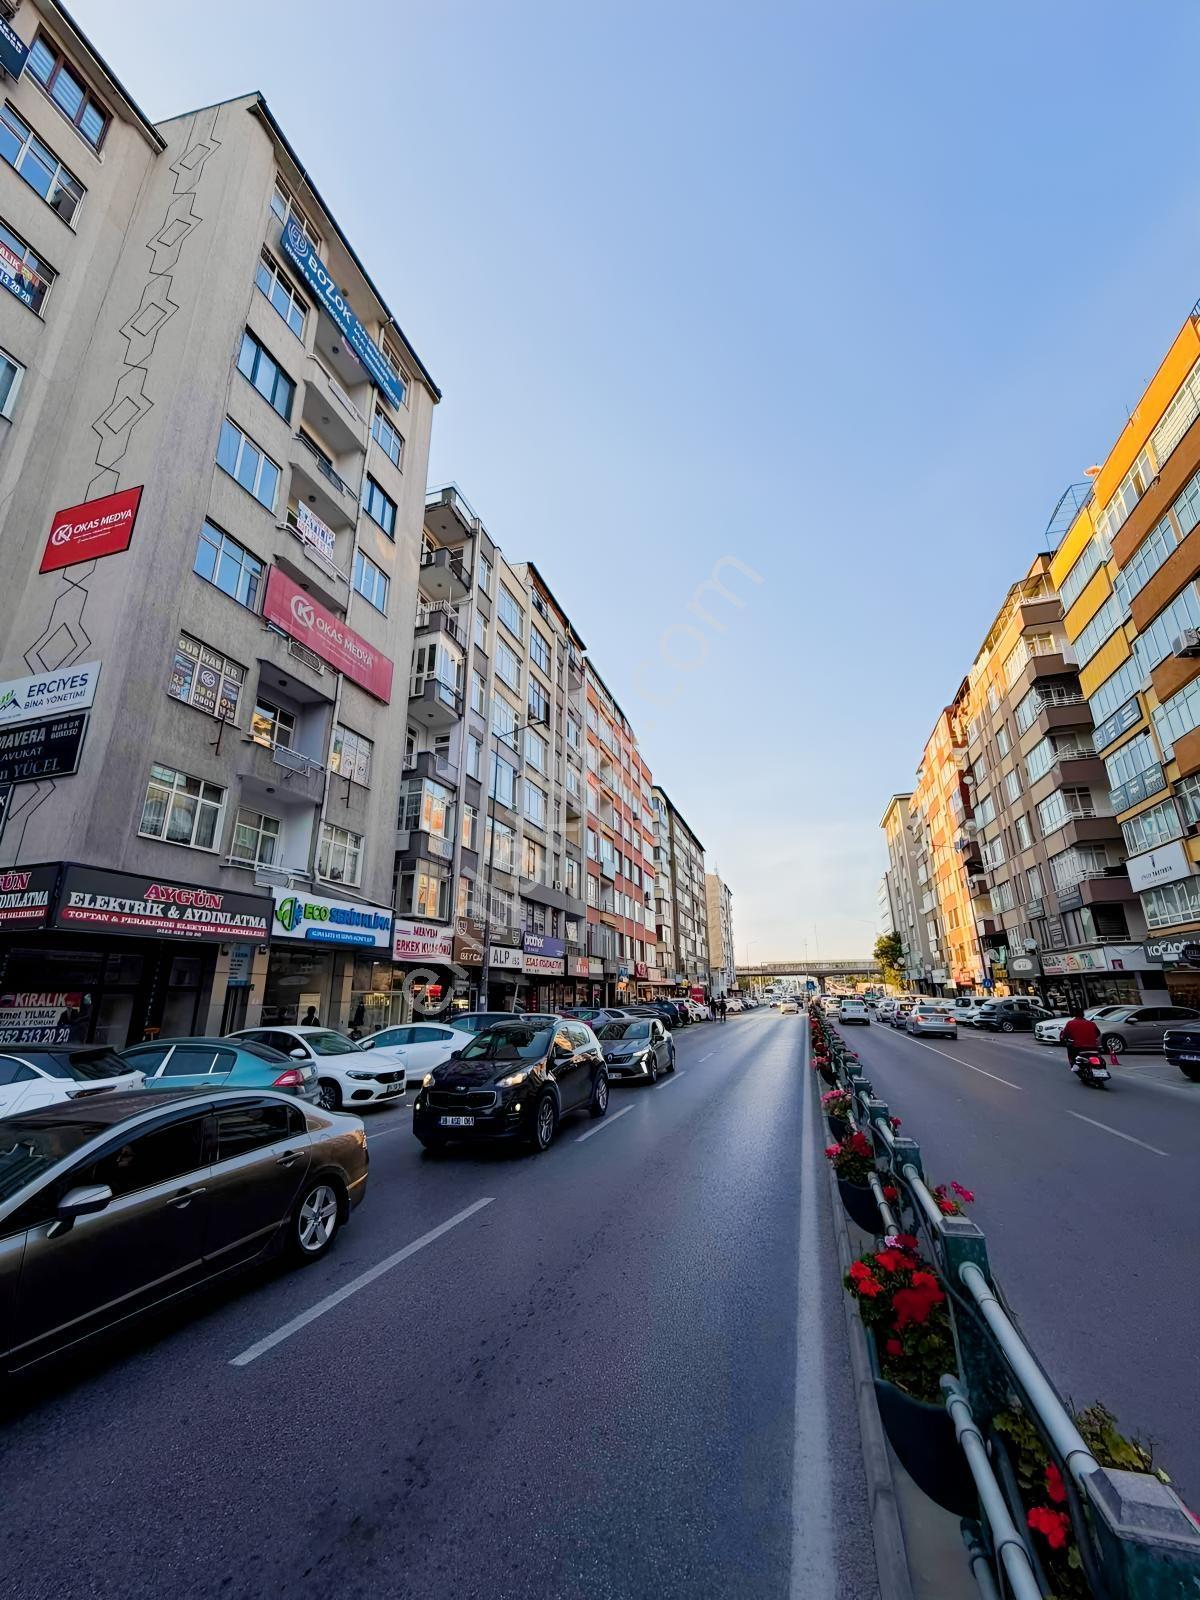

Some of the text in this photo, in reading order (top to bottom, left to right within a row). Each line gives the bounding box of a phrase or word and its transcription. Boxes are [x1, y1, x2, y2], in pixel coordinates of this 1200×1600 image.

[307, 256, 353, 325] BOZOK
[74, 519, 101, 534] OKAS
[101, 509, 133, 526] MEDYA
[316, 617, 343, 644] OKAS
[344, 638, 374, 668] MEDYA
[24, 687, 87, 710] BİNA YÖNETİMİ
[13, 757, 61, 779] YÜCEL
[144, 882, 224, 910] AYGÜN
[67, 910, 110, 922] TOPTAN
[68, 891, 267, 929] ELEKTRİK & AYDINLATMA
[303, 902, 330, 922] ECO
[396, 939, 421, 954] ERKEK
[492, 949, 510, 964] ALP
[24, 1009, 57, 1019] YILMAZ
[20, 1029, 41, 1043] 513
[41, 1029, 56, 1044] 20
[56, 1028, 71, 1043] 20
